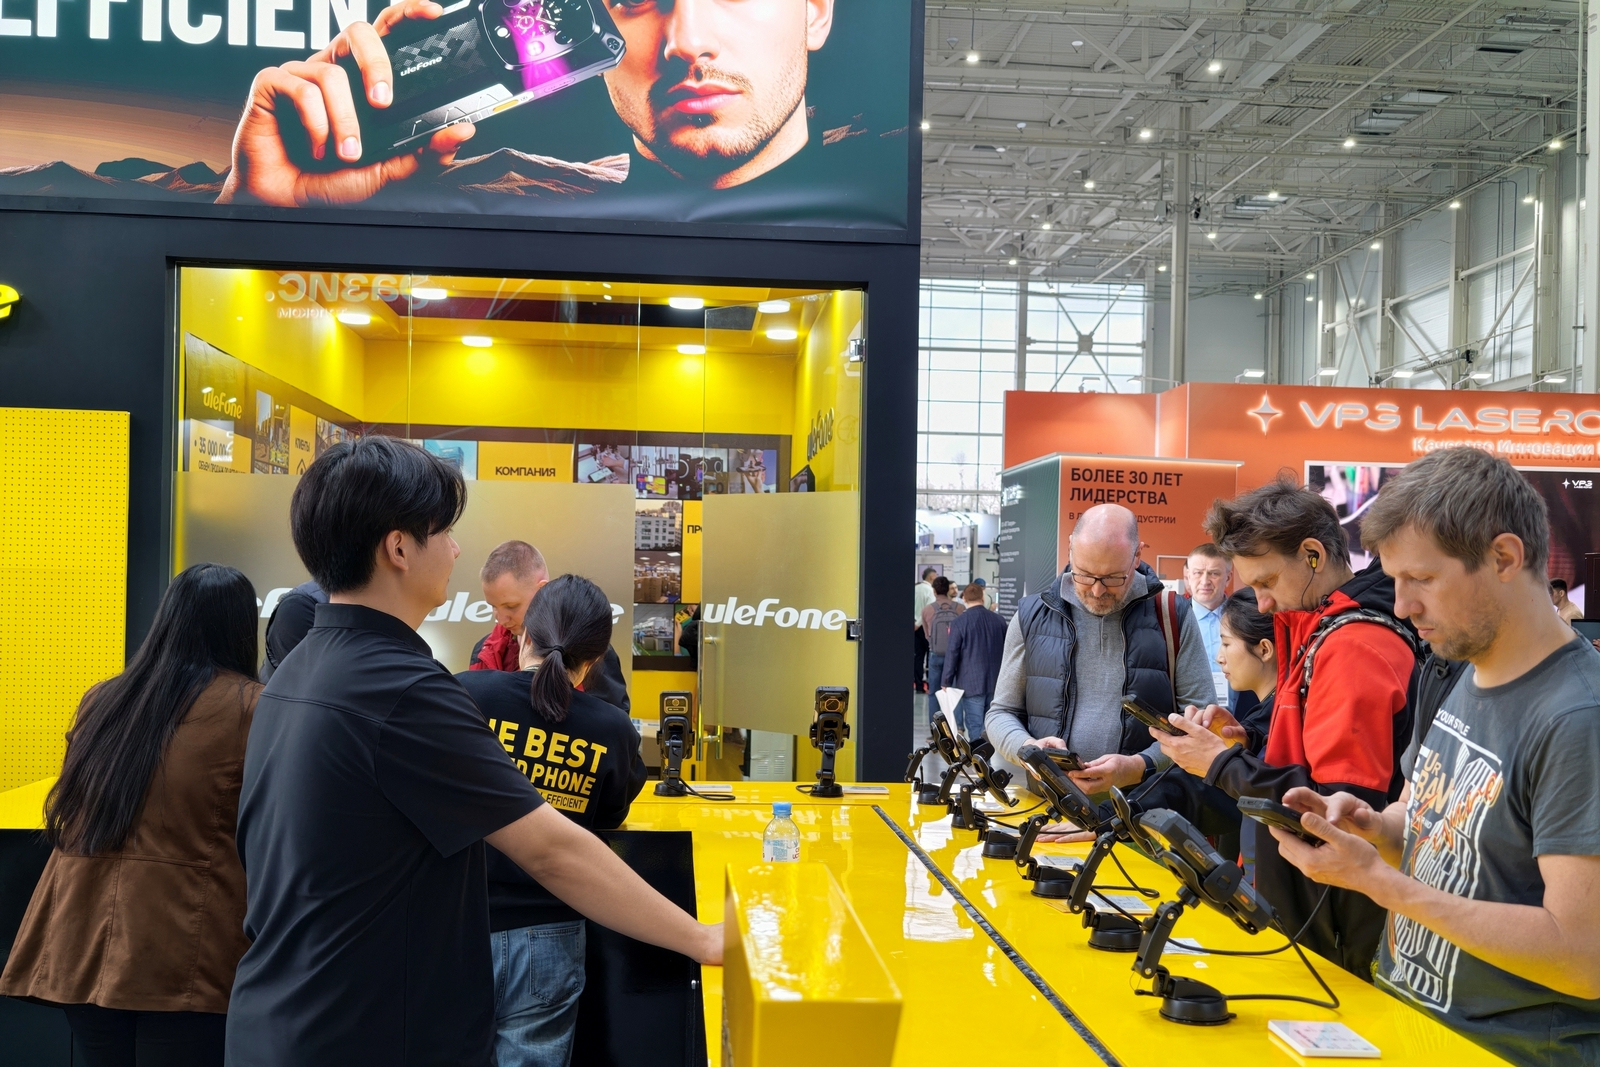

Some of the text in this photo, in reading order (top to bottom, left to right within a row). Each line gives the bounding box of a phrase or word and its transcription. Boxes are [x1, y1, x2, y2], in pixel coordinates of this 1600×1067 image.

[495, 466, 556, 477] КОМПАНИЯ
[1071, 468, 1183, 486] БОЛЕЕ 30 ЛЕТ
[1070, 487, 1168, 505] ЛИДЕРСТВА
[1069, 512, 1075, 520] В
[523, 726, 608, 774] BEST
[530, 763, 597, 796] PHONE
[546, 793, 584, 810] EFFICIENT
